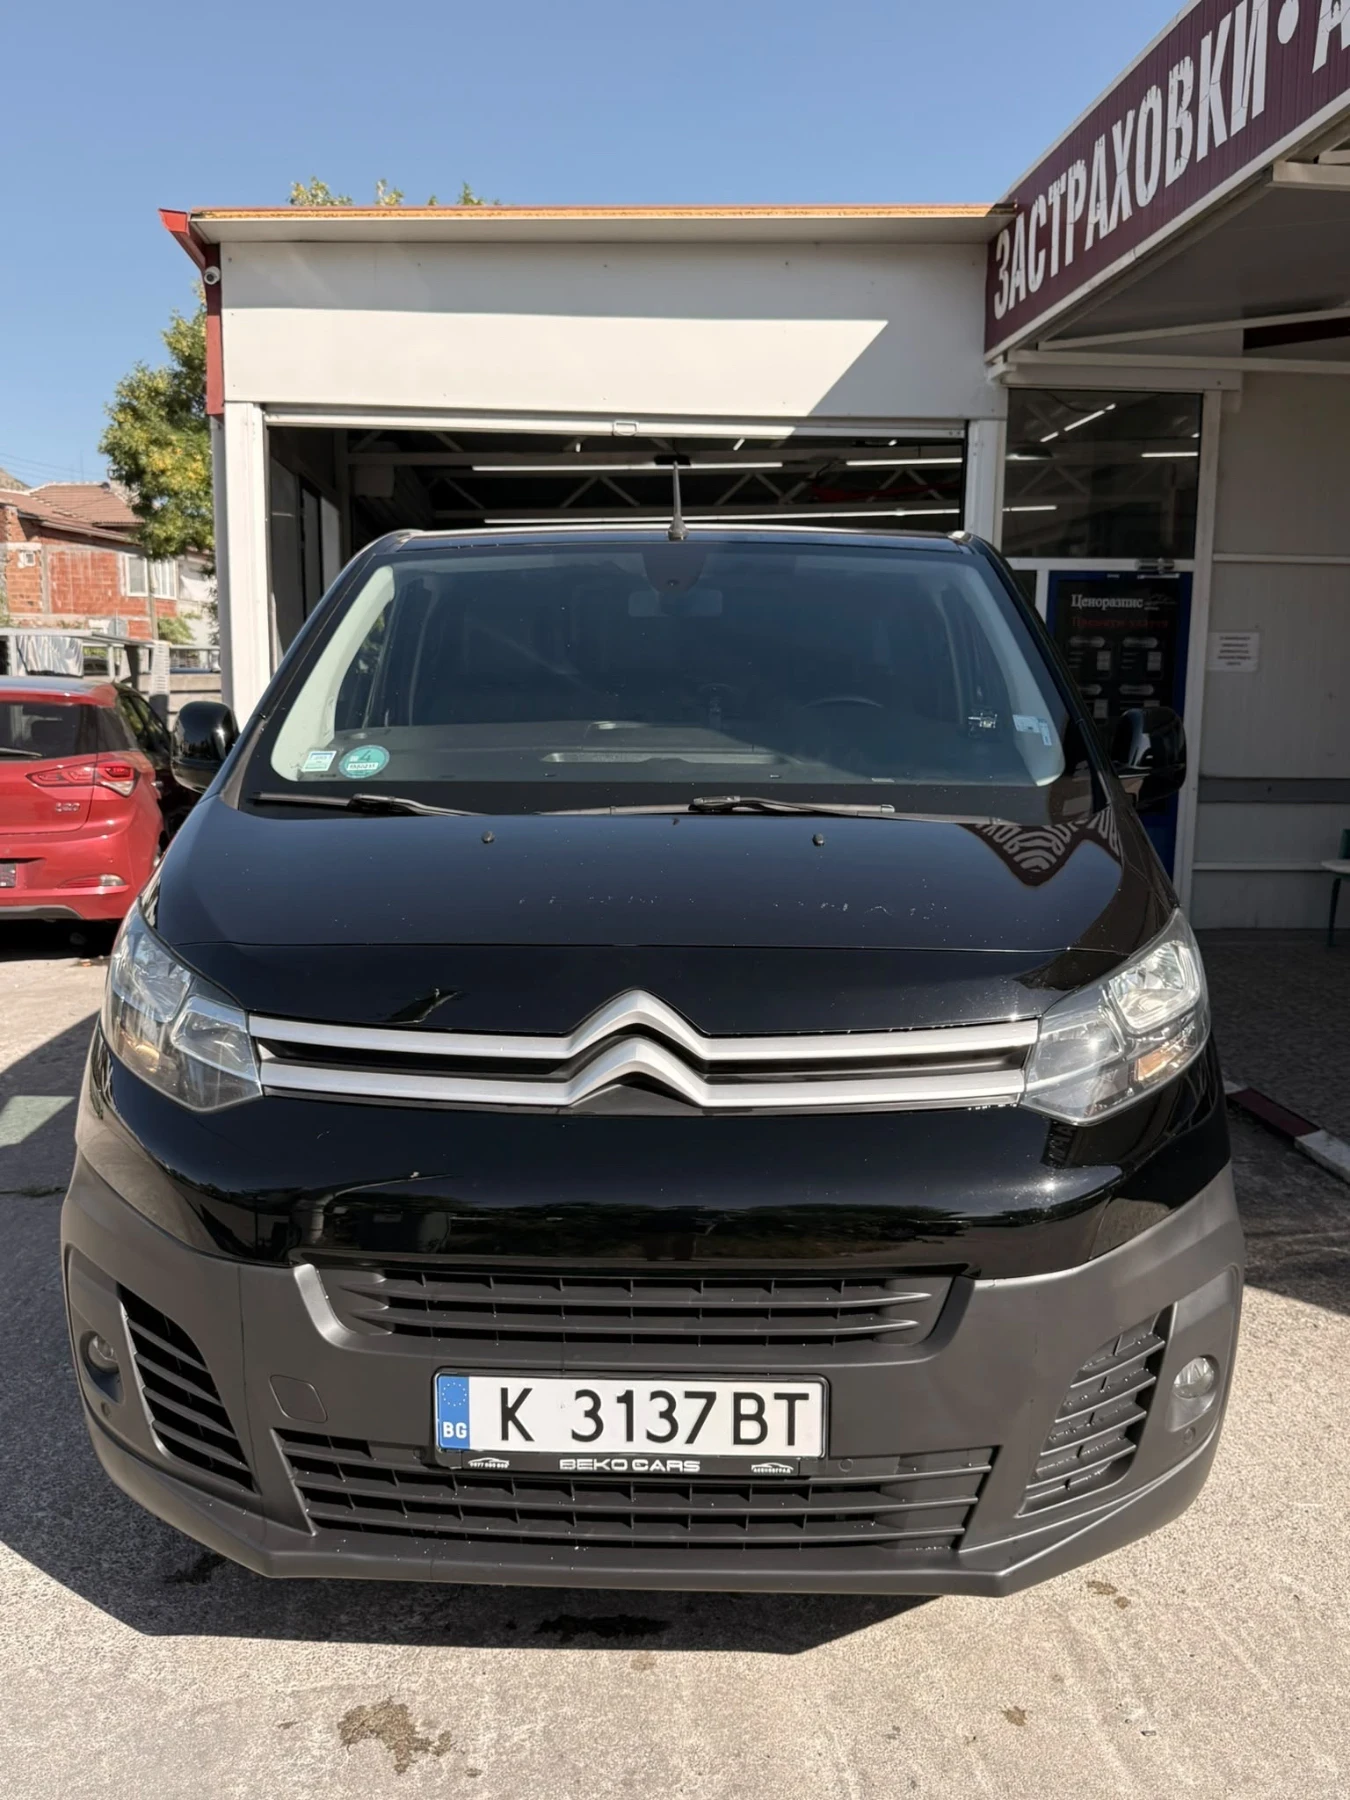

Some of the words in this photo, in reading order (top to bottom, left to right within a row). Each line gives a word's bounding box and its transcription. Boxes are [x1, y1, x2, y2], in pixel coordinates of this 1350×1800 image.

[994, 0, 1269, 320] ЗАСТРАХОВКИ
[442, 1421, 467, 1439] BG
[500, 1387, 535, 1442] K
[559, 1458, 630, 1472] BEKO
[632, 1459, 701, 1473] CARS
